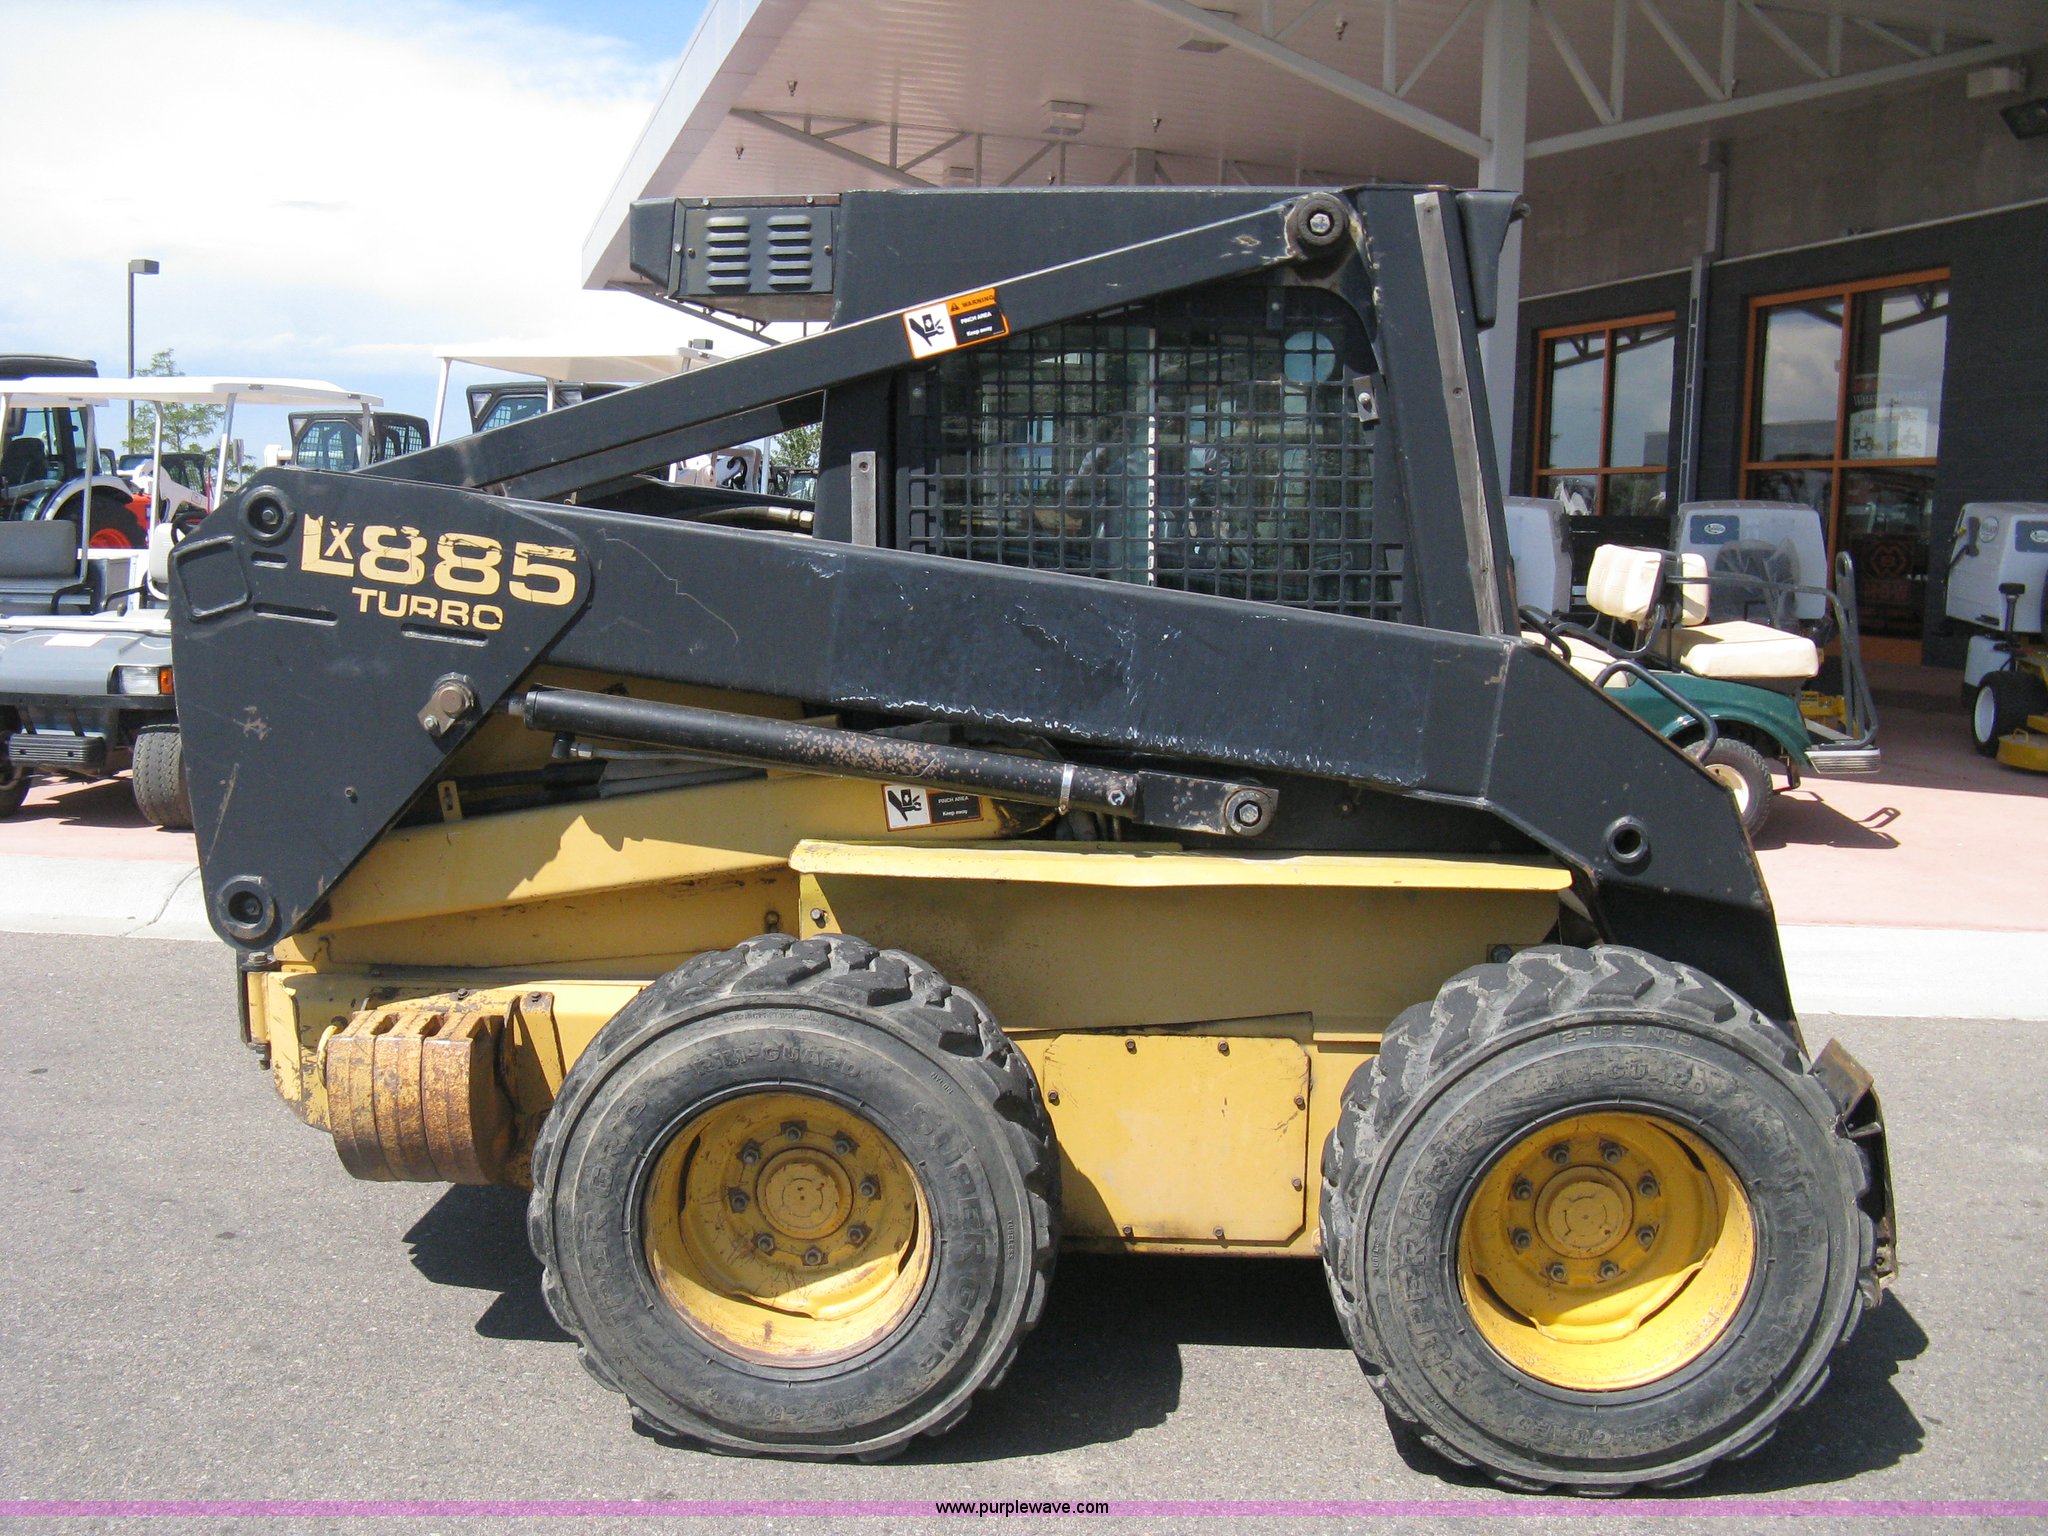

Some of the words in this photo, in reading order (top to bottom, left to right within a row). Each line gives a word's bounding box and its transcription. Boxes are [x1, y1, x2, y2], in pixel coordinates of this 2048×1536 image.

[961, 295, 994, 308] WARNING
[960, 315, 977, 325] PINCH
[977, 311, 993, 321] AREA
[966, 328, 980, 337] Keep
[351, 586, 504, 631] TURBO
[910, 1102, 986, 1264] SUPER
